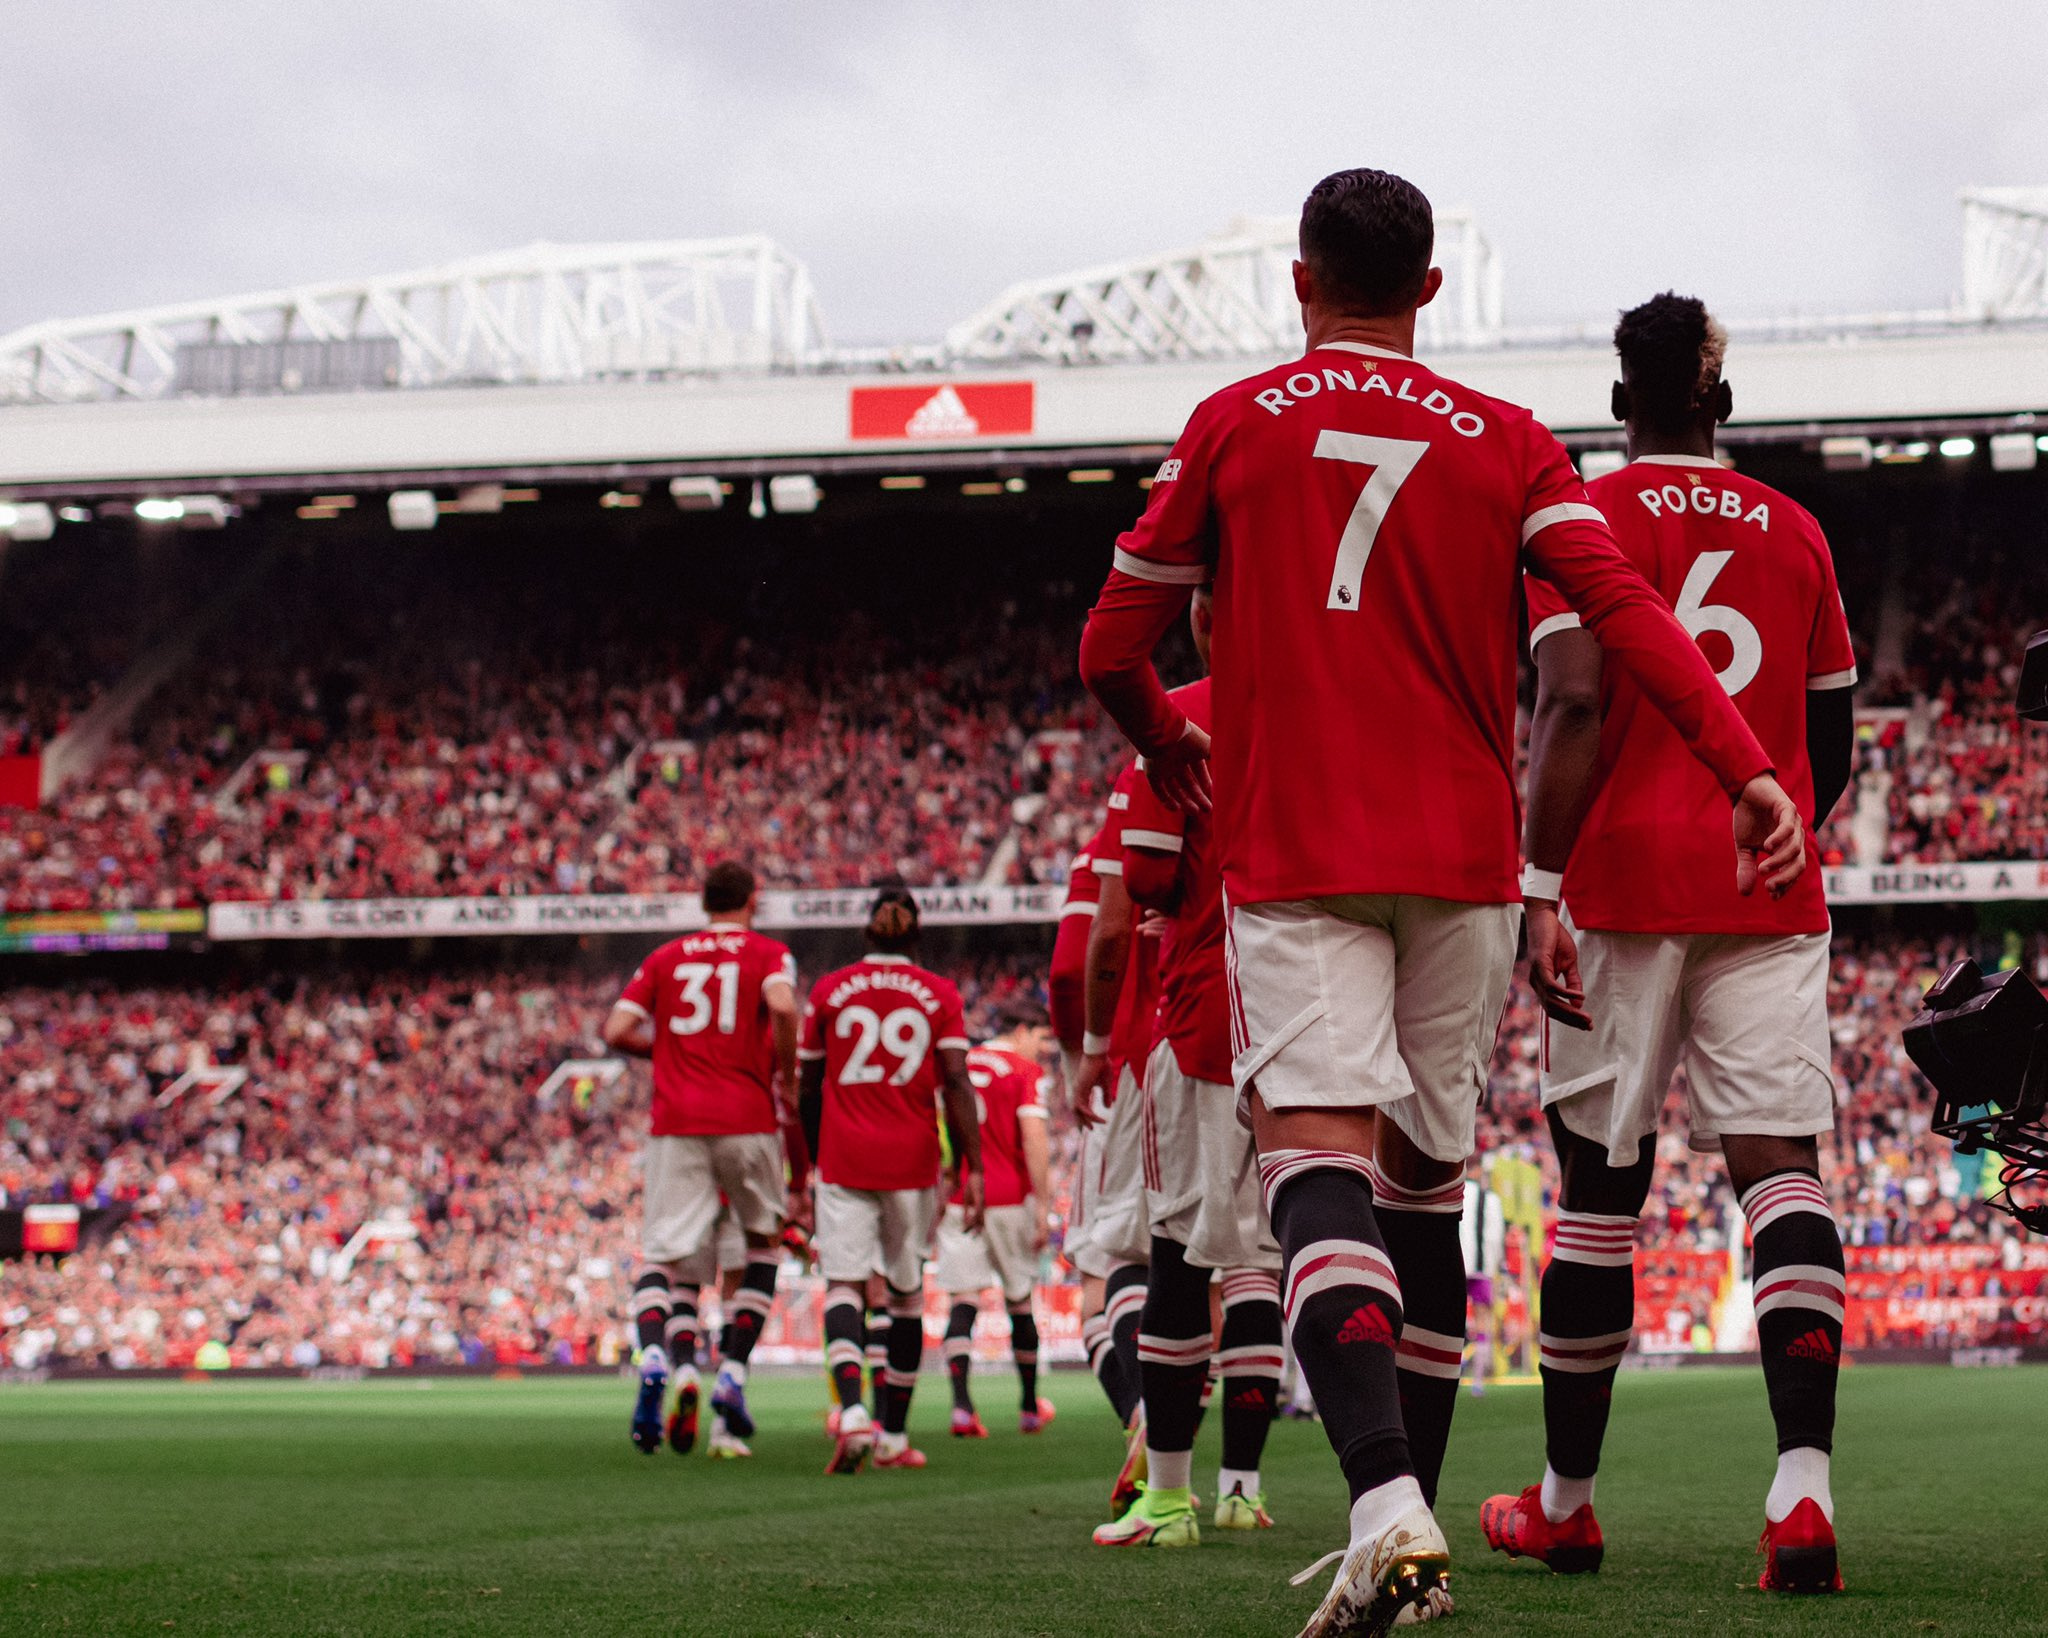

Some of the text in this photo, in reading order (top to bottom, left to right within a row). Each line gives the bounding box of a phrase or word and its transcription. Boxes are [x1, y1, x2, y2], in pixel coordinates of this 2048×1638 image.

[1253, 368, 1485, 438] RONALDO
[1312, 429, 1431, 612] 7
[1637, 484, 1770, 533] POGBA
[1673, 550, 1763, 697] 6
[789, 898, 876, 917] GREA
[920, 893, 989, 913] MAN
[1871, 869, 1967, 895] BEING
[326, 906, 427, 928] GLORY
[453, 905, 515, 922] AND
[669, 961, 740, 1035] 31
[835, 1004, 932, 1086] 29
